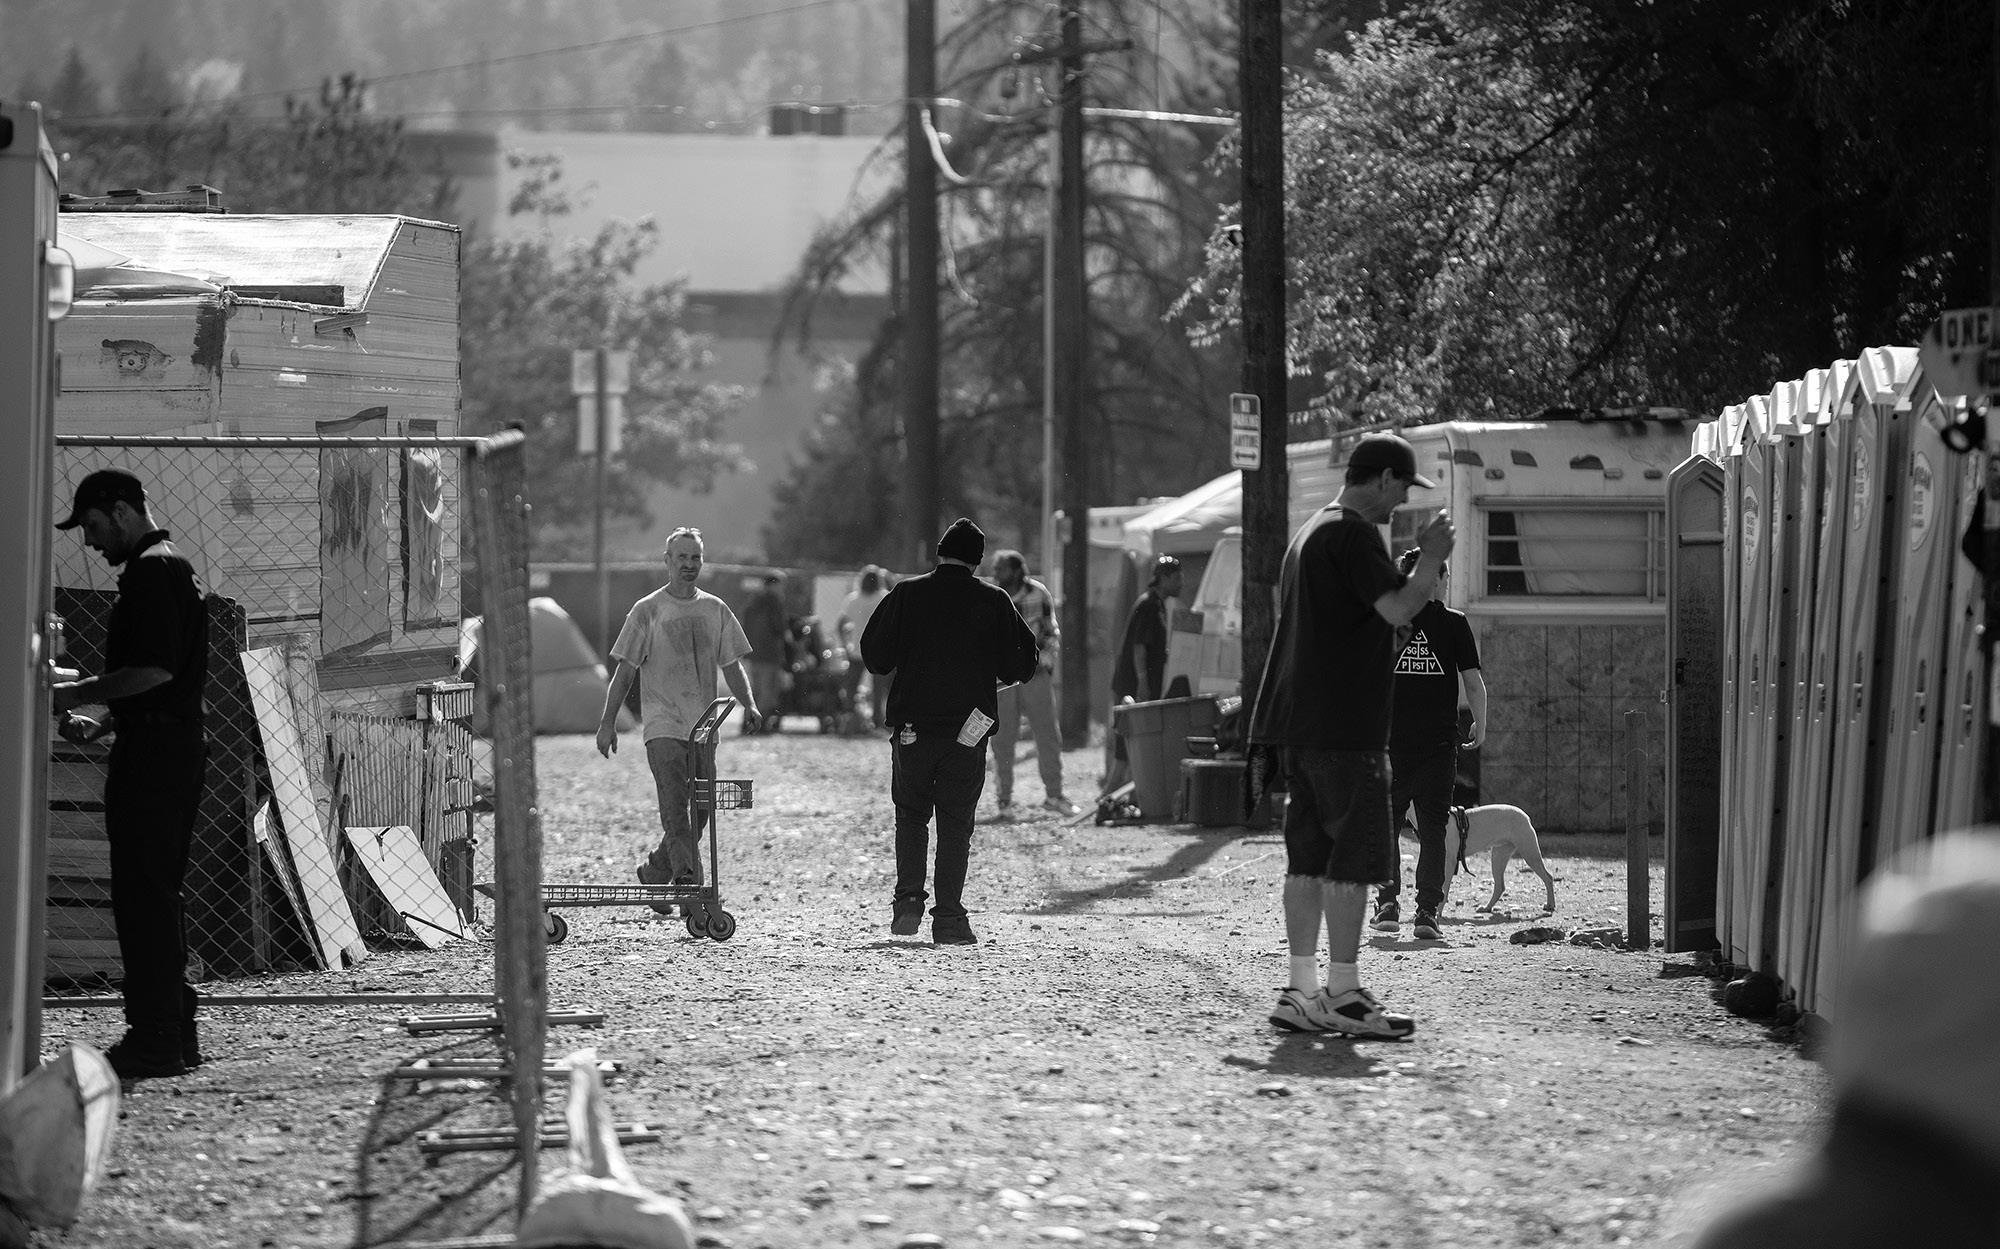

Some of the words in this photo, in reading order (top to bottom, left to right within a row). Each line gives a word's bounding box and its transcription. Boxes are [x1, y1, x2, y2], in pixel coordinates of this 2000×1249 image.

[1407, 646, 1417, 655] SG
[1420, 646, 1429, 655] SS
[1402, 661, 1408, 669] P
[1412, 661, 1425, 670] PST
[1430, 661, 1436, 670] V
